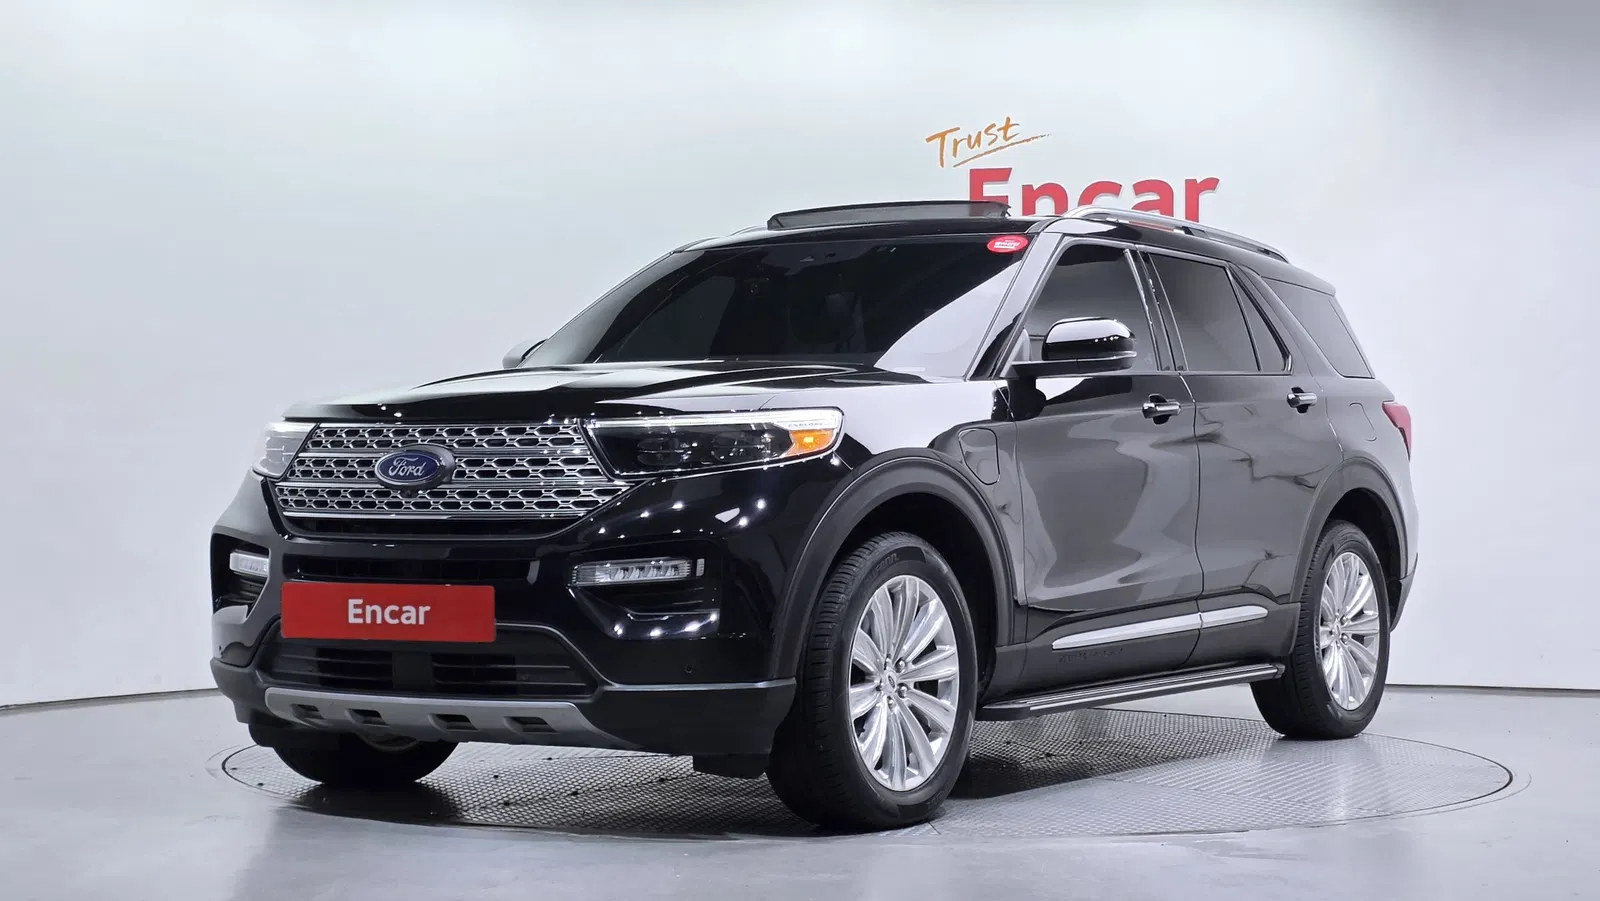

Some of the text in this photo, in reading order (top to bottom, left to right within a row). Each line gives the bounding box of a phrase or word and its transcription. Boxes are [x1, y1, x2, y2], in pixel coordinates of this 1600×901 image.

[925, 116, 1020, 168] Trust
[969, 167, 1220, 222] Encar
[388, 456, 427, 477] Ford
[347, 598, 431, 625] Encar
